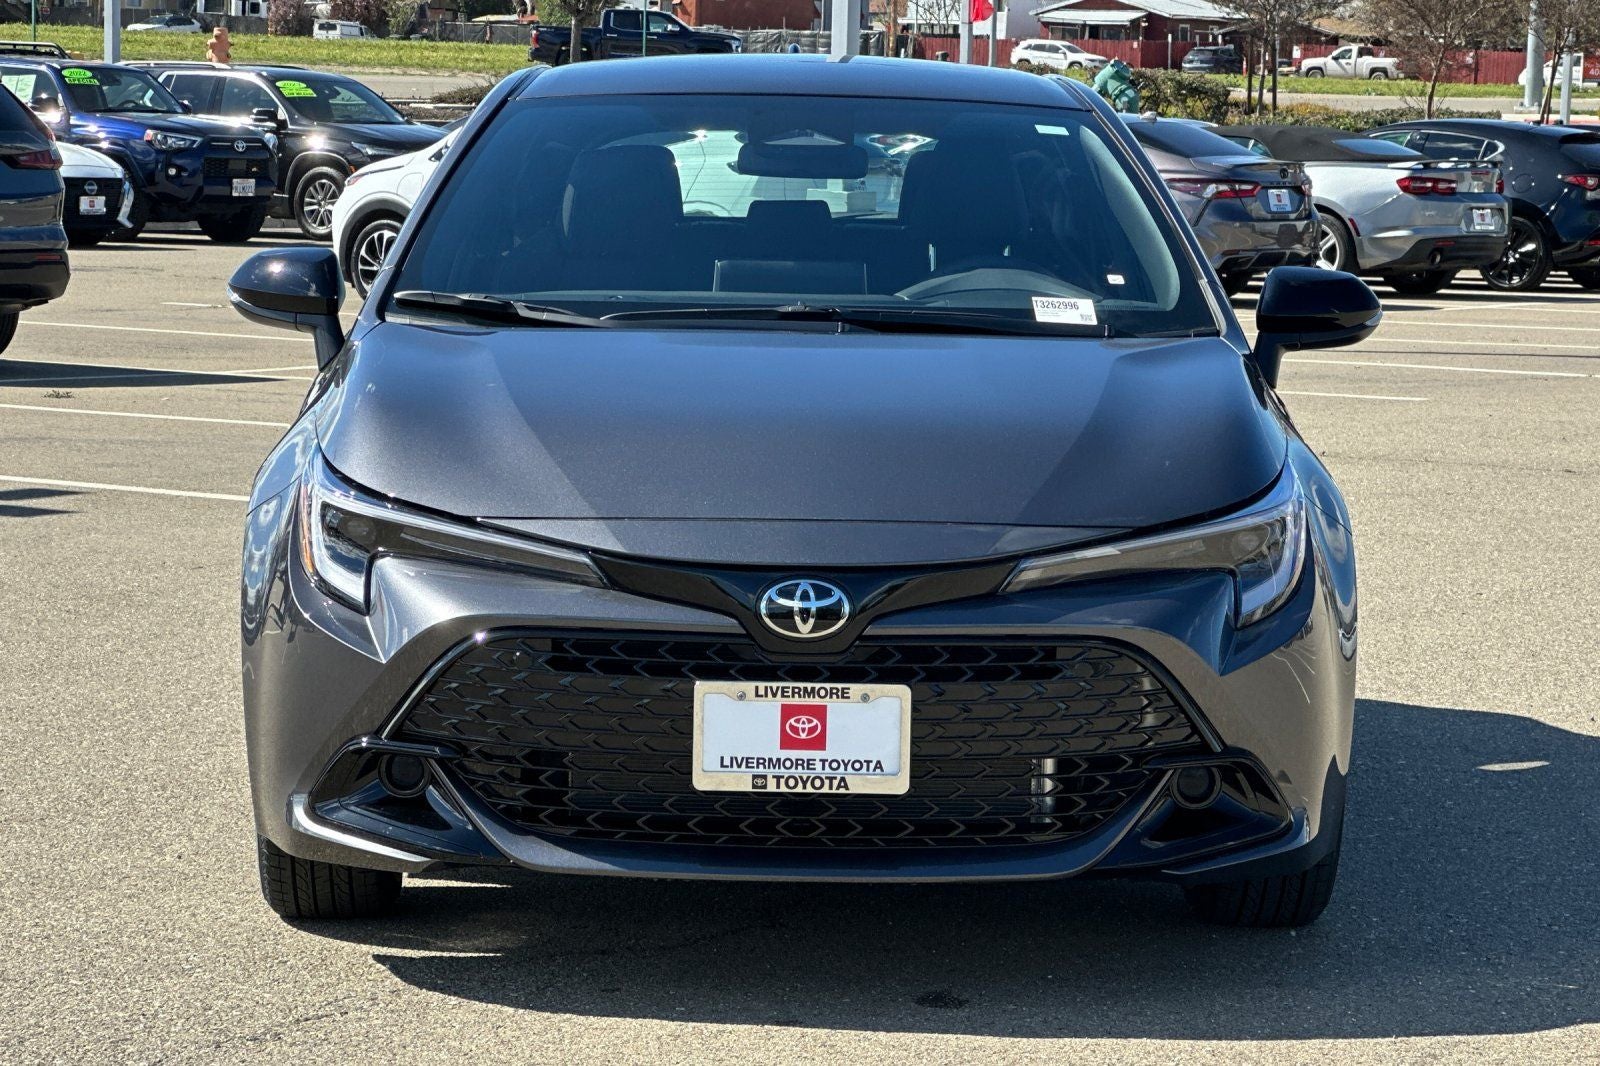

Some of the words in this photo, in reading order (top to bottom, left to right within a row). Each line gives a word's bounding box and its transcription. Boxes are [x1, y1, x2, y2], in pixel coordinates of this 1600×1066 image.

[1034, 300, 1080, 310] T3262996
[754, 685, 850, 699] LIVERMORE
[719, 756, 816, 771] LIVERMORE
[819, 758, 884, 772] TOYOTA
[772, 775, 849, 791] TOYOTA
